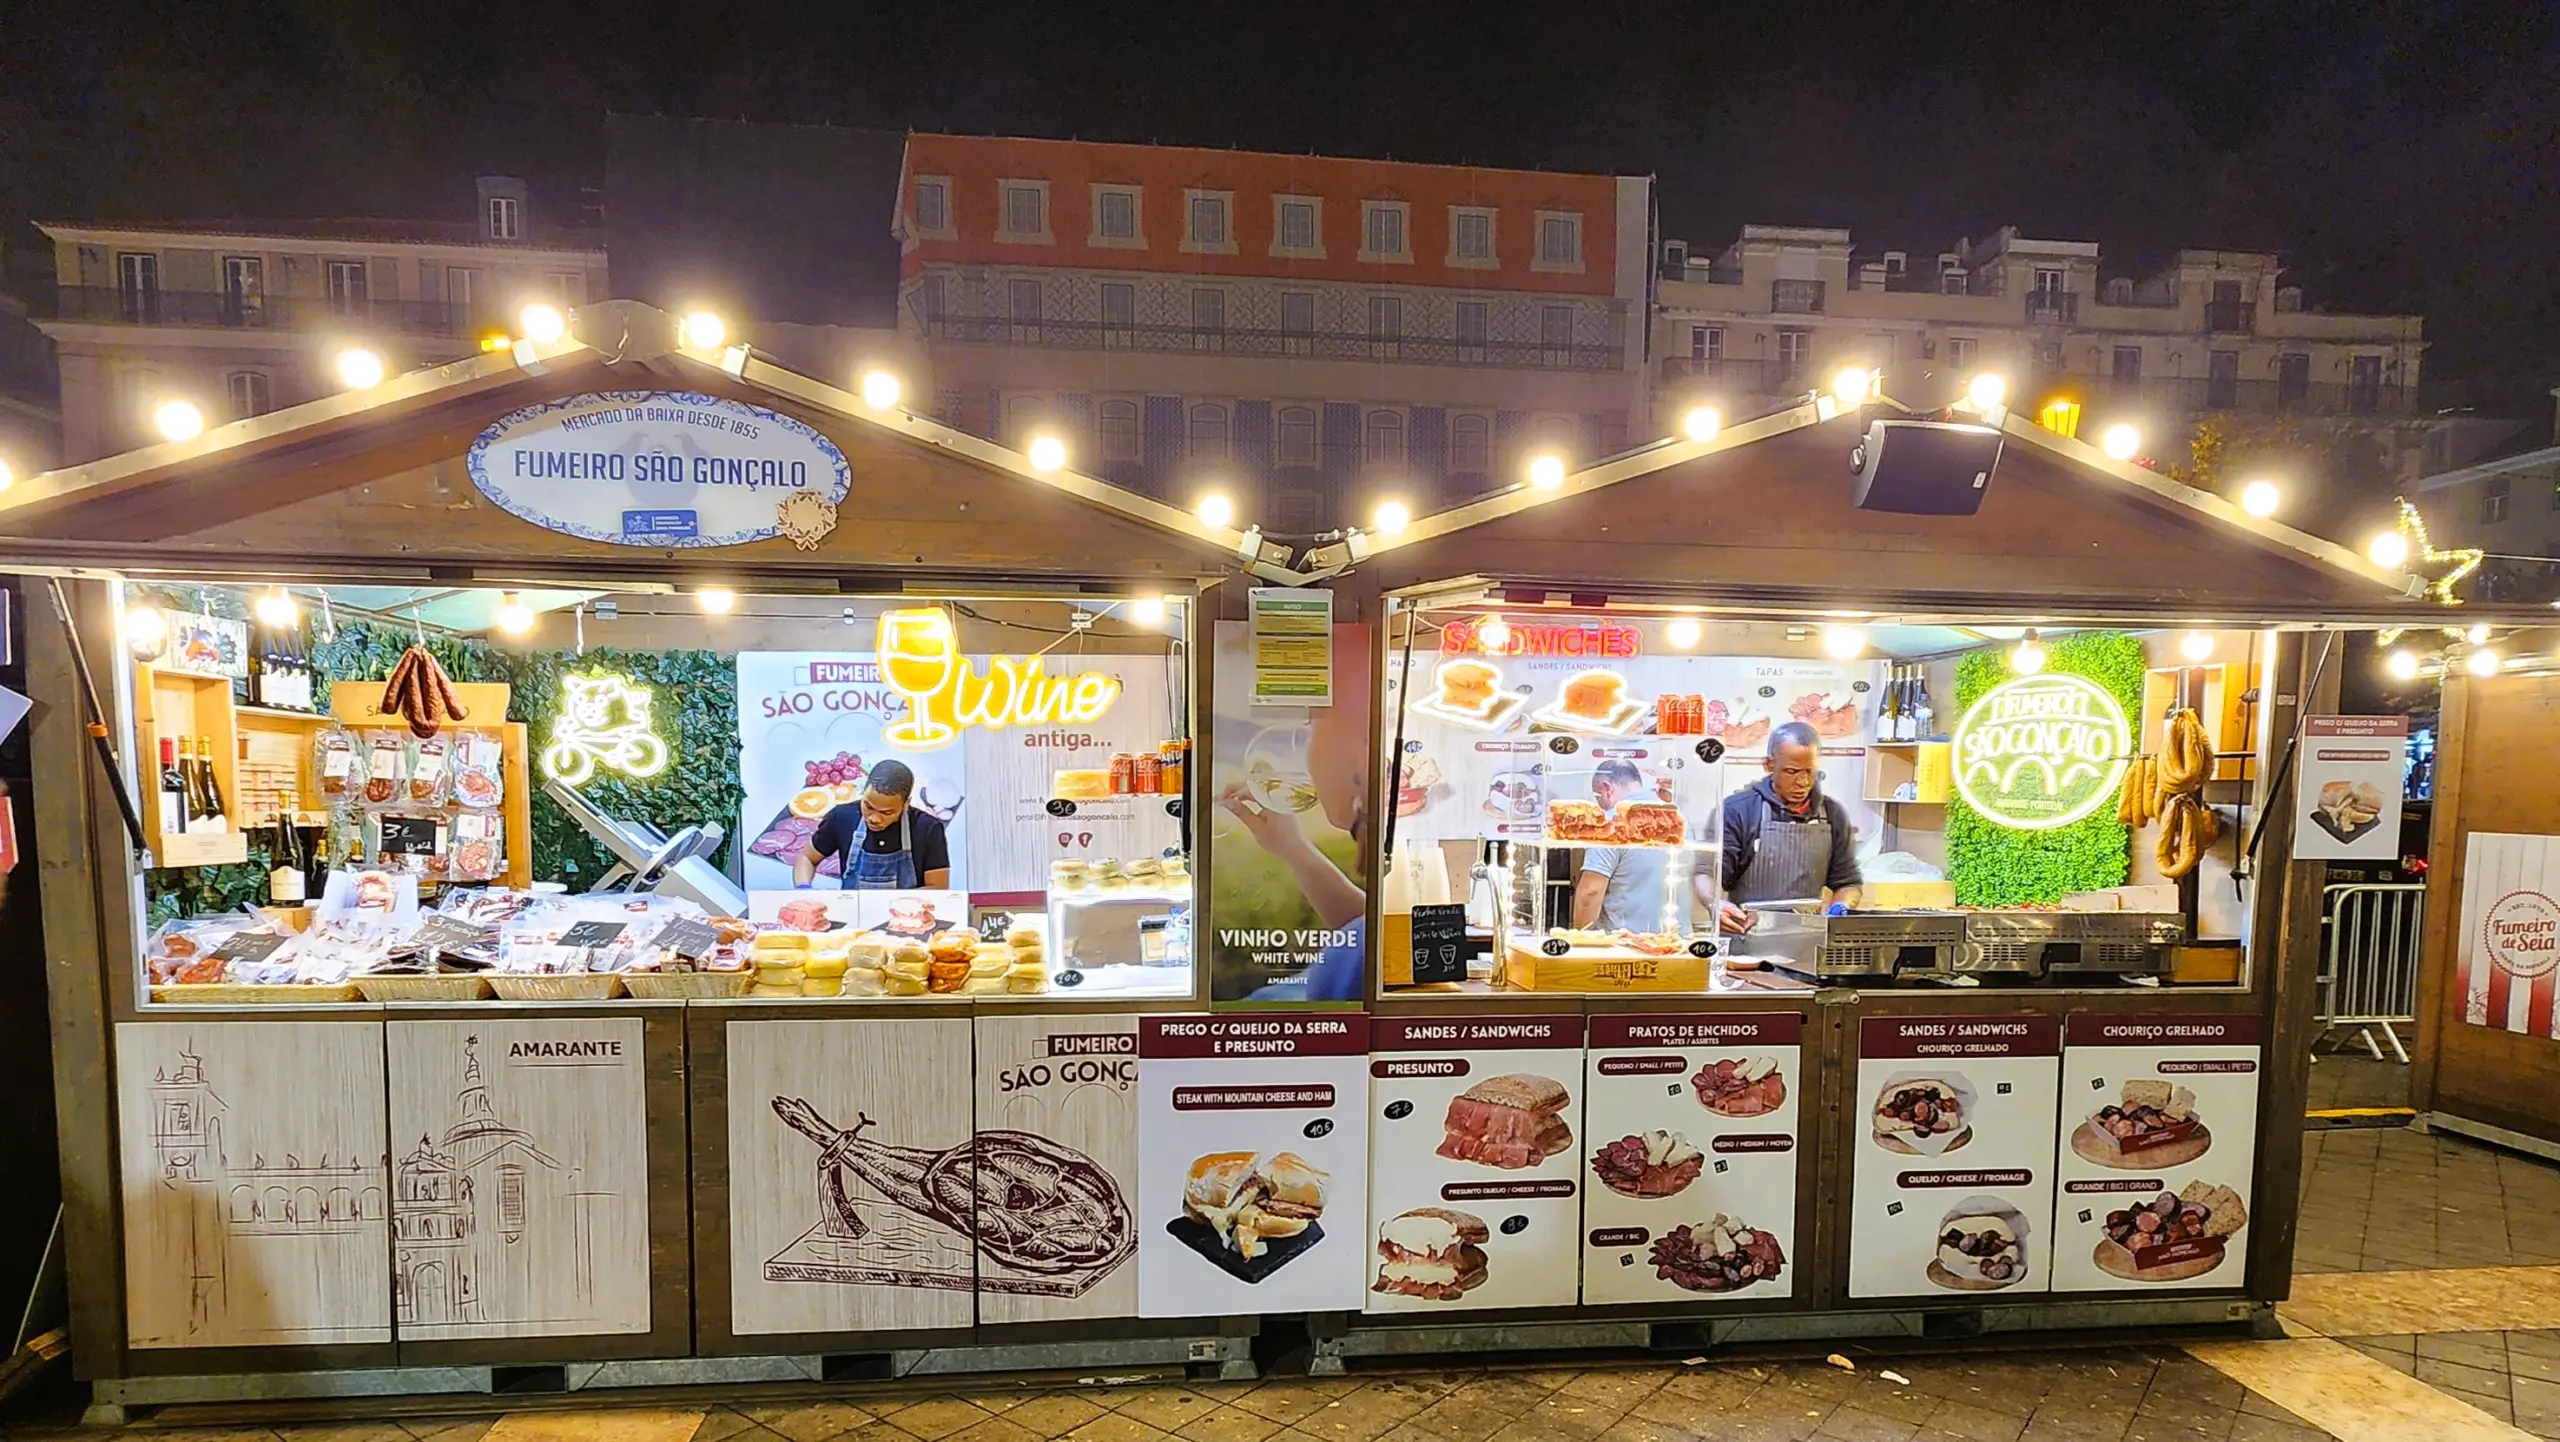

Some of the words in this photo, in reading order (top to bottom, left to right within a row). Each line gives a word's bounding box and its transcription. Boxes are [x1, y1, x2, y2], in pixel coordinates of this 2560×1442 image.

[561, 409, 622, 432] MERCADO
[624, 408, 643, 422] DA
[647, 408, 684, 422] BAIXA
[688, 410, 728, 430] DESDE
[730, 420, 760, 439] 1855
[514, 450, 624, 480] FUMEIRO
[634, 450, 683, 482] SÃO
[693, 457, 806, 492] GONÇALO
[1444, 622, 1638, 658] SADWICHES
[816, 665, 880, 682] FUMEIR
[953, 659, 1117, 725] Wine
[762, 690, 813, 718] SÃO
[1023, 729, 1113, 751] antiga...
[1051, 800, 1073, 815] 3€
[1171, 801, 1181, 813] 7
[2492, 918, 2557, 935] Fumeiro
[1219, 929, 1288, 948] VINHO
[1294, 929, 1357, 948] VERDE
[2502, 936, 2517, 949] de
[2517, 933, 2556, 952] Seia
[1251, 952, 1290, 964] WHITE
[1293, 952, 1325, 964] WINE
[1267, 976, 1308, 985] AMARANTE
[1161, 1024, 1208, 1036] PREGO
[1210, 1023, 1226, 1036] C/
[1229, 1023, 1281, 1036] QUEIJO
[1284, 1022, 1303, 1034] DA
[1306, 1022, 1348, 1035] SERRA
[1404, 1026, 1458, 1040] SANDES
[1471, 1025, 1551, 1038] SANDWICHS
[1628, 1027, 1676, 1038] PRATOS
[1679, 1026, 1694, 1037] DE
[1698, 1025, 1759, 1037] ENCHIDOS
[1899, 1025, 1946, 1037] SANDES
[1957, 1024, 2028, 1036] SANDWICHS
[2103, 1026, 2163, 1040] CHOURIÇO
[2165, 1025, 2225, 1037] GRELHADO
[509, 1041, 622, 1057] AMARANTE
[1054, 1036, 1133, 1053] FUMEIRO
[1214, 1041, 1222, 1053] E
[1225, 1040, 1295, 1053] PRESUNTO
[1662, 1038, 1686, 1046] PLATES
[1917, 1044, 1963, 1055] CHOURIÇO
[1964, 1044, 2009, 1053] GRELHADO
[1387, 1062, 1454, 1075] PRESUNTO
[2160, 1063, 2198, 1072] PEQUENO
[2202, 1063, 2227, 1071] SMALL
[2231, 1062, 2253, 1071] PETIT
[1000, 1063, 1052, 1092] SÃO
[1176, 1093, 1203, 1104] STEAK
[1203, 1093, 1223, 1104] WITH
[1224, 1092, 1265, 1104] MOUNTAIN
[1265, 1091, 1296, 1103] CHEESE
[1297, 1091, 1313, 1102] AND
[1314, 1090, 1332, 1101] HAM
[1908, 1175, 1940, 1184] QUEIJO
[1946, 1174, 1978, 1183] CHEESE
[1984, 1173, 2026, 1182] FROMAGE
[1448, 1187, 1482, 1196] PRESUNTO
[1482, 1187, 1506, 1195] QUEIJO
[1511, 1186, 1535, 1194] CHEESE
[1539, 1185, 1571, 1193] FROMAGE
[2071, 1183, 2104, 1191] GRANDE
[2110, 1182, 2124, 1190] BIG
[2129, 1182, 2157, 1190] GRAND
